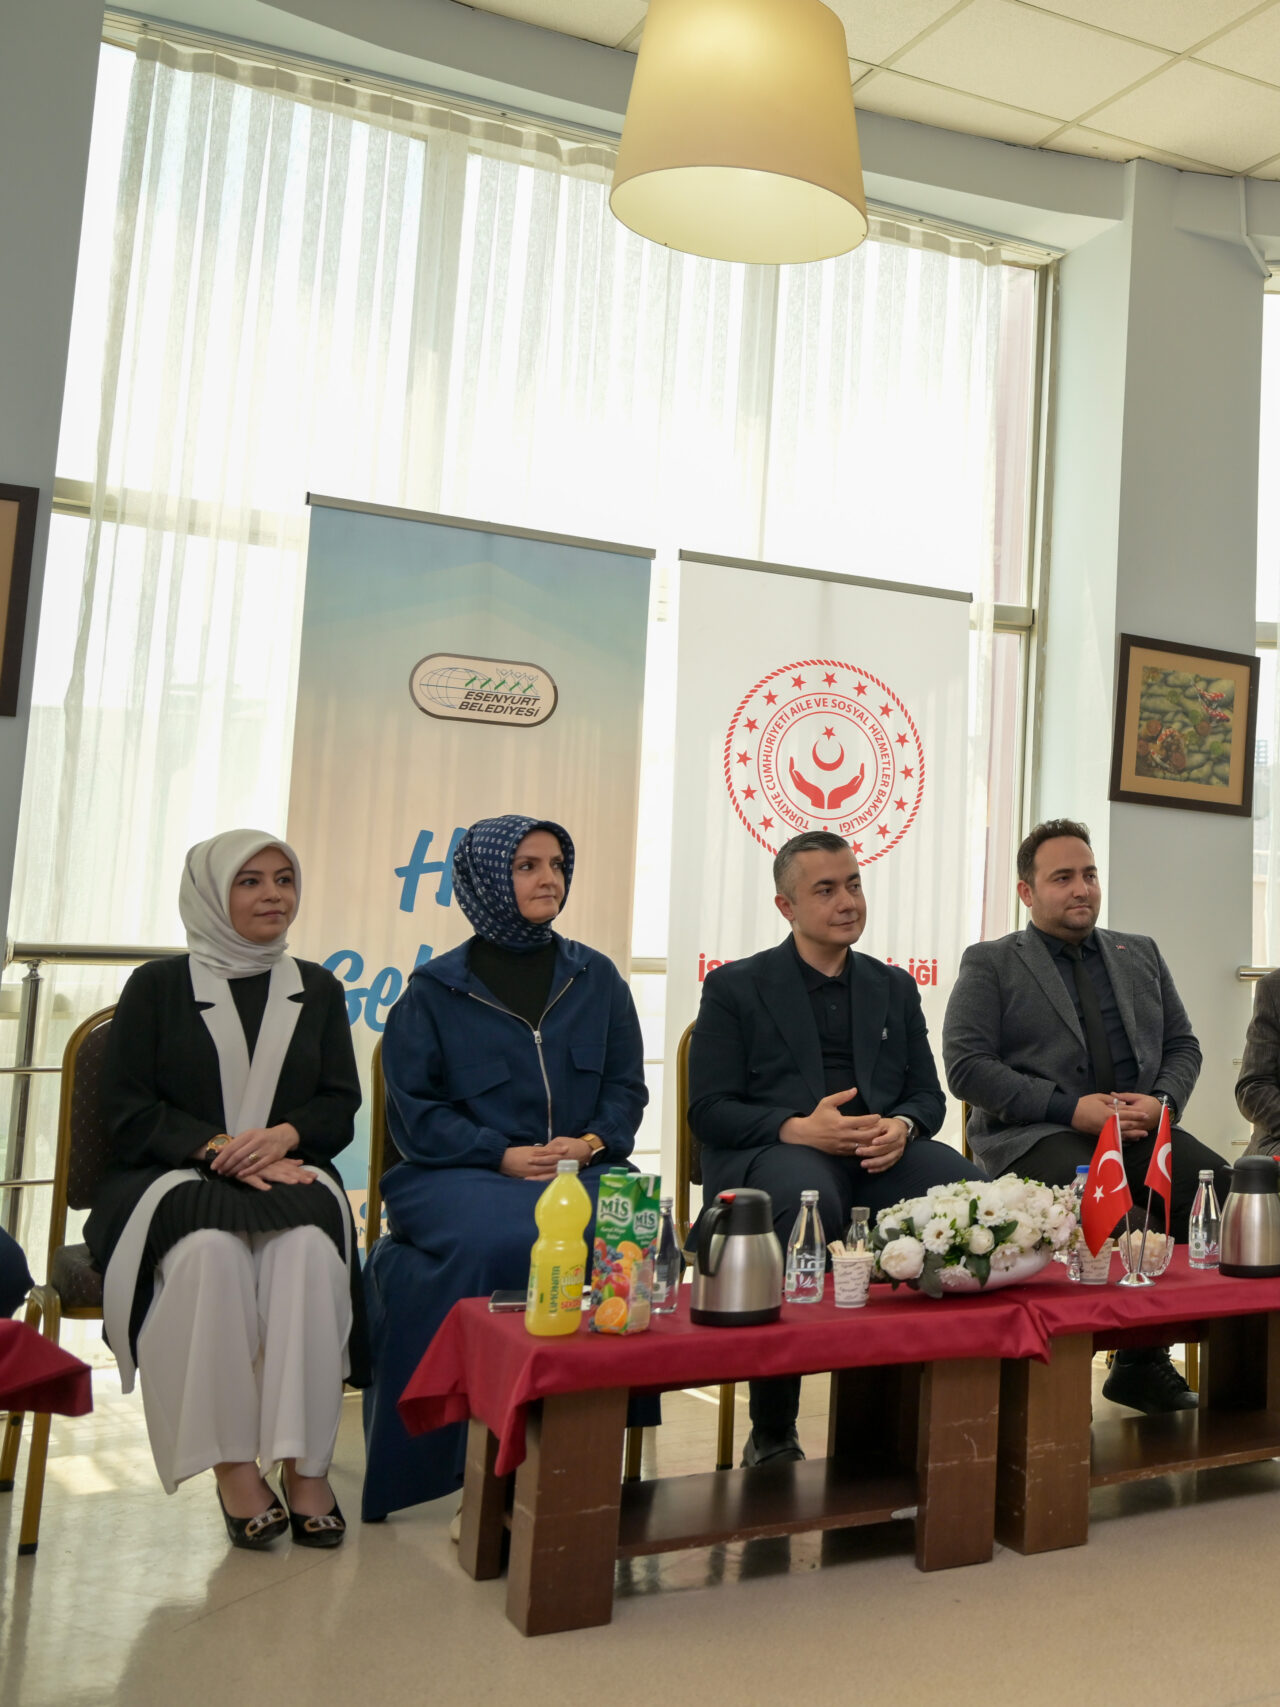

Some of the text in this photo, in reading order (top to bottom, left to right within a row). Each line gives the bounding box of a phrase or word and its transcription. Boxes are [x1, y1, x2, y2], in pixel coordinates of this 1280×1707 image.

[464, 691, 541, 707] ESENYURT
[458, 701, 541, 717] BELEDİYESİ
[763, 698, 891, 833] TÜRKİYE CUMHURİYETİ AİLE VE SOSYAL HİZMETLER BAKANLIĞI
